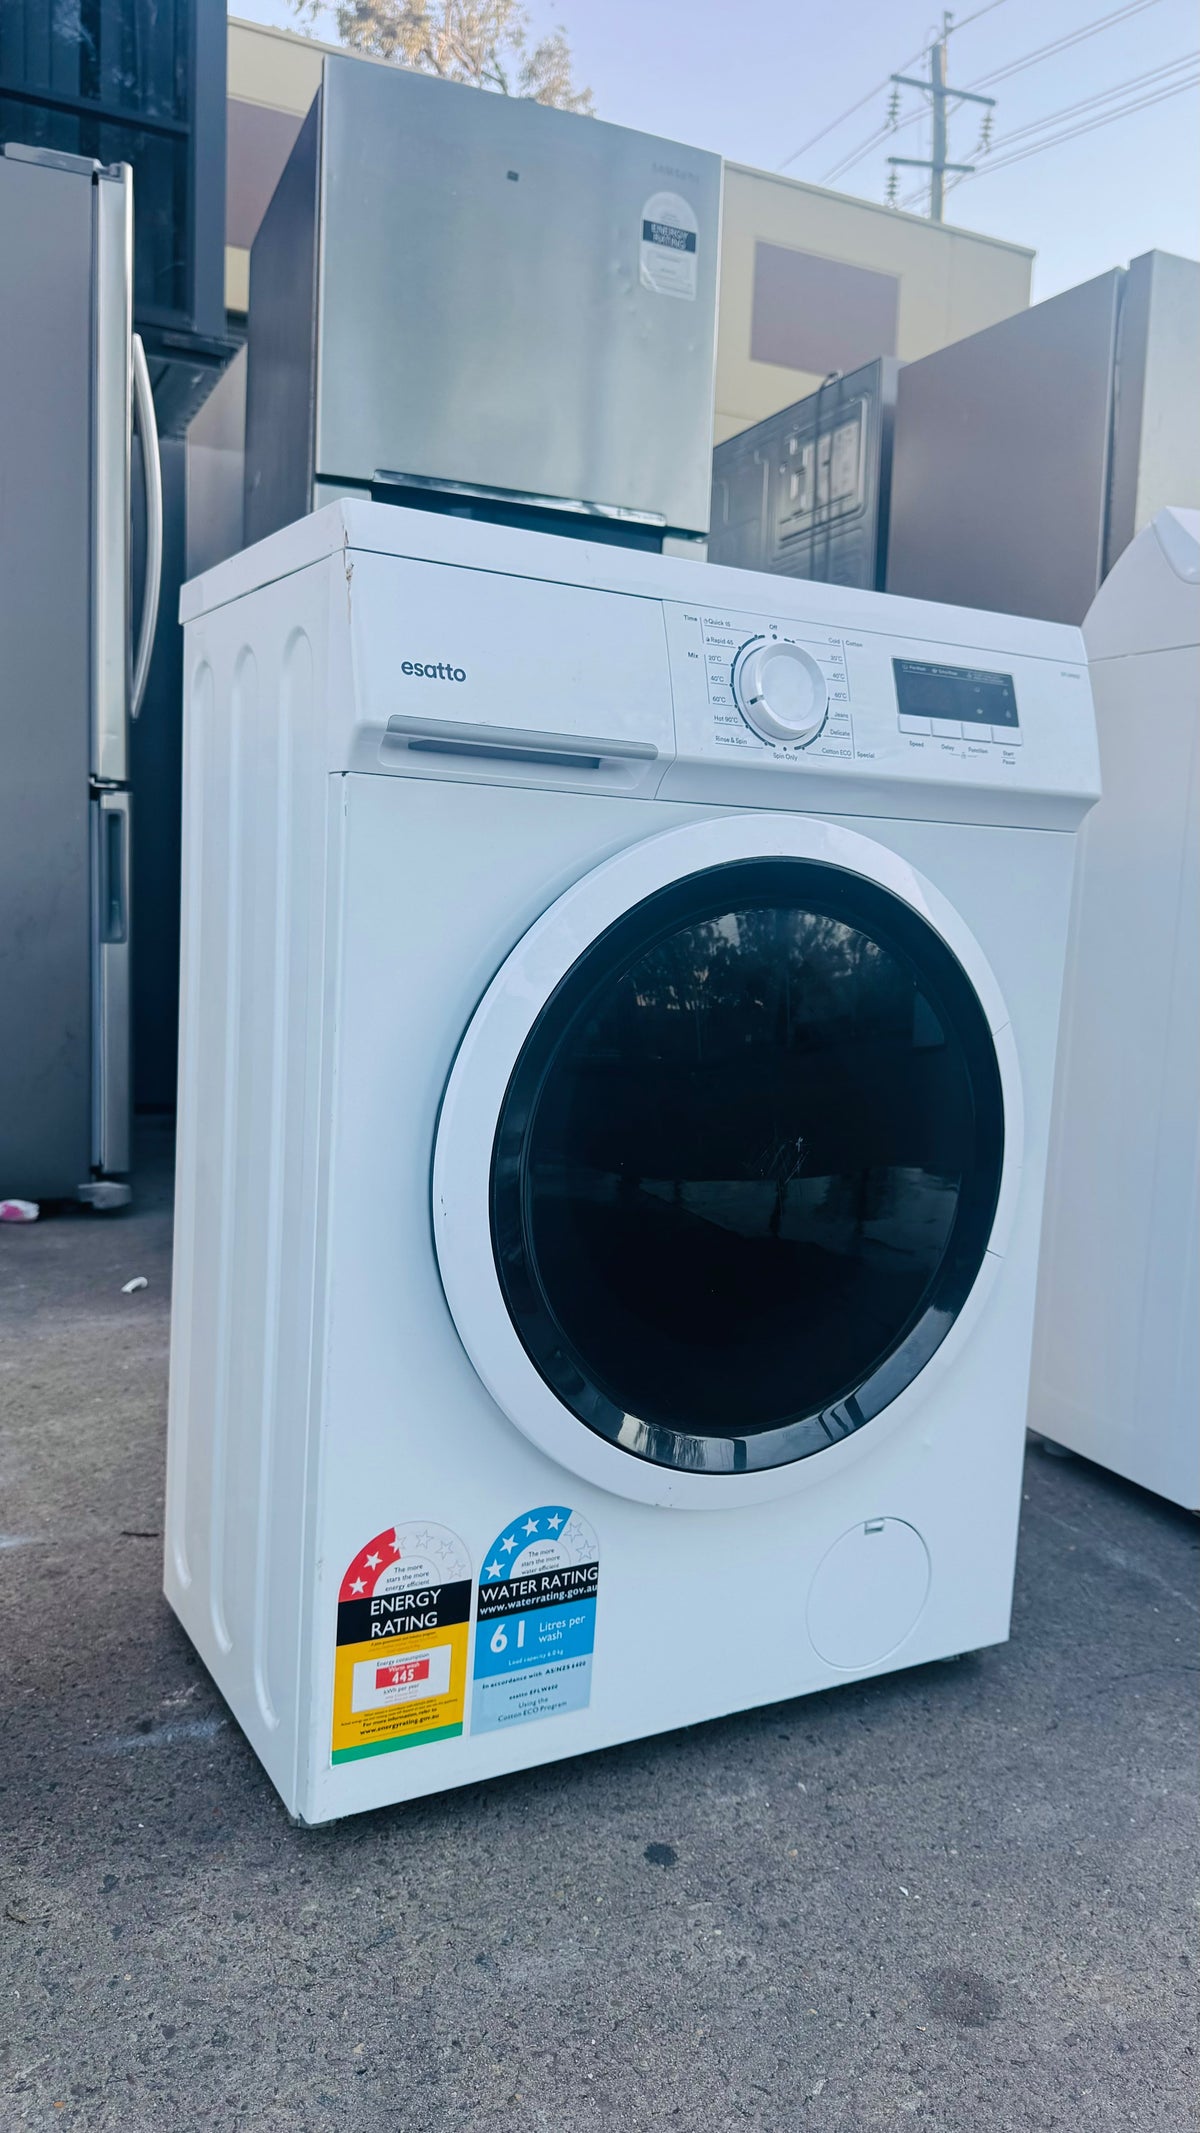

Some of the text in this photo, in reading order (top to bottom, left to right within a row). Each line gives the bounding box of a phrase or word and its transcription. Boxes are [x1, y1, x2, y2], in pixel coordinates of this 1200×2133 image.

[683, 614, 698, 622] Time
[708, 618, 723, 626] Quick
[710, 636, 726, 645] Rapid
[687, 651, 699, 659] Mix
[401, 661, 466, 682] esatto
[830, 728, 850, 736] Delicate
[715, 735, 731, 743] Rinse
[735, 738, 747, 746] Spin
[909, 740, 924, 748] Speed
[821, 747, 852, 757] Cotton ECO
[941, 744, 955, 752] Delay
[968, 746, 988, 754] Function
[773, 752, 798, 761] Spin Only
[856, 751, 875, 759] Special
[539, 1563, 559, 1571] efficient
[407, 1579, 430, 1587] efficient
[481, 1566, 598, 1602] WATER RATING
[370, 1588, 441, 1616] ENERGY
[480, 1584, 598, 1615] www.waterrating.gov.au
[371, 1611, 438, 1638] RATING
[490, 1615, 586, 1653] 61 Litres per
[538, 1630, 562, 1643] wash
[376, 1652, 430, 1668] Energy consumption
[508, 1657, 522, 1666] Load
[388, 1665, 405, 1673] Warm
[392, 1668, 414, 1684] 445
[490, 1675, 527, 1687] accordance
[528, 1671, 542, 1679] with
[408, 1683, 420, 1692] year
[518, 1699, 536, 1709] Using
[498, 1701, 567, 1723] Cotton ECO Program
[360, 1714, 440, 1735] www.energyrating.gov.au
